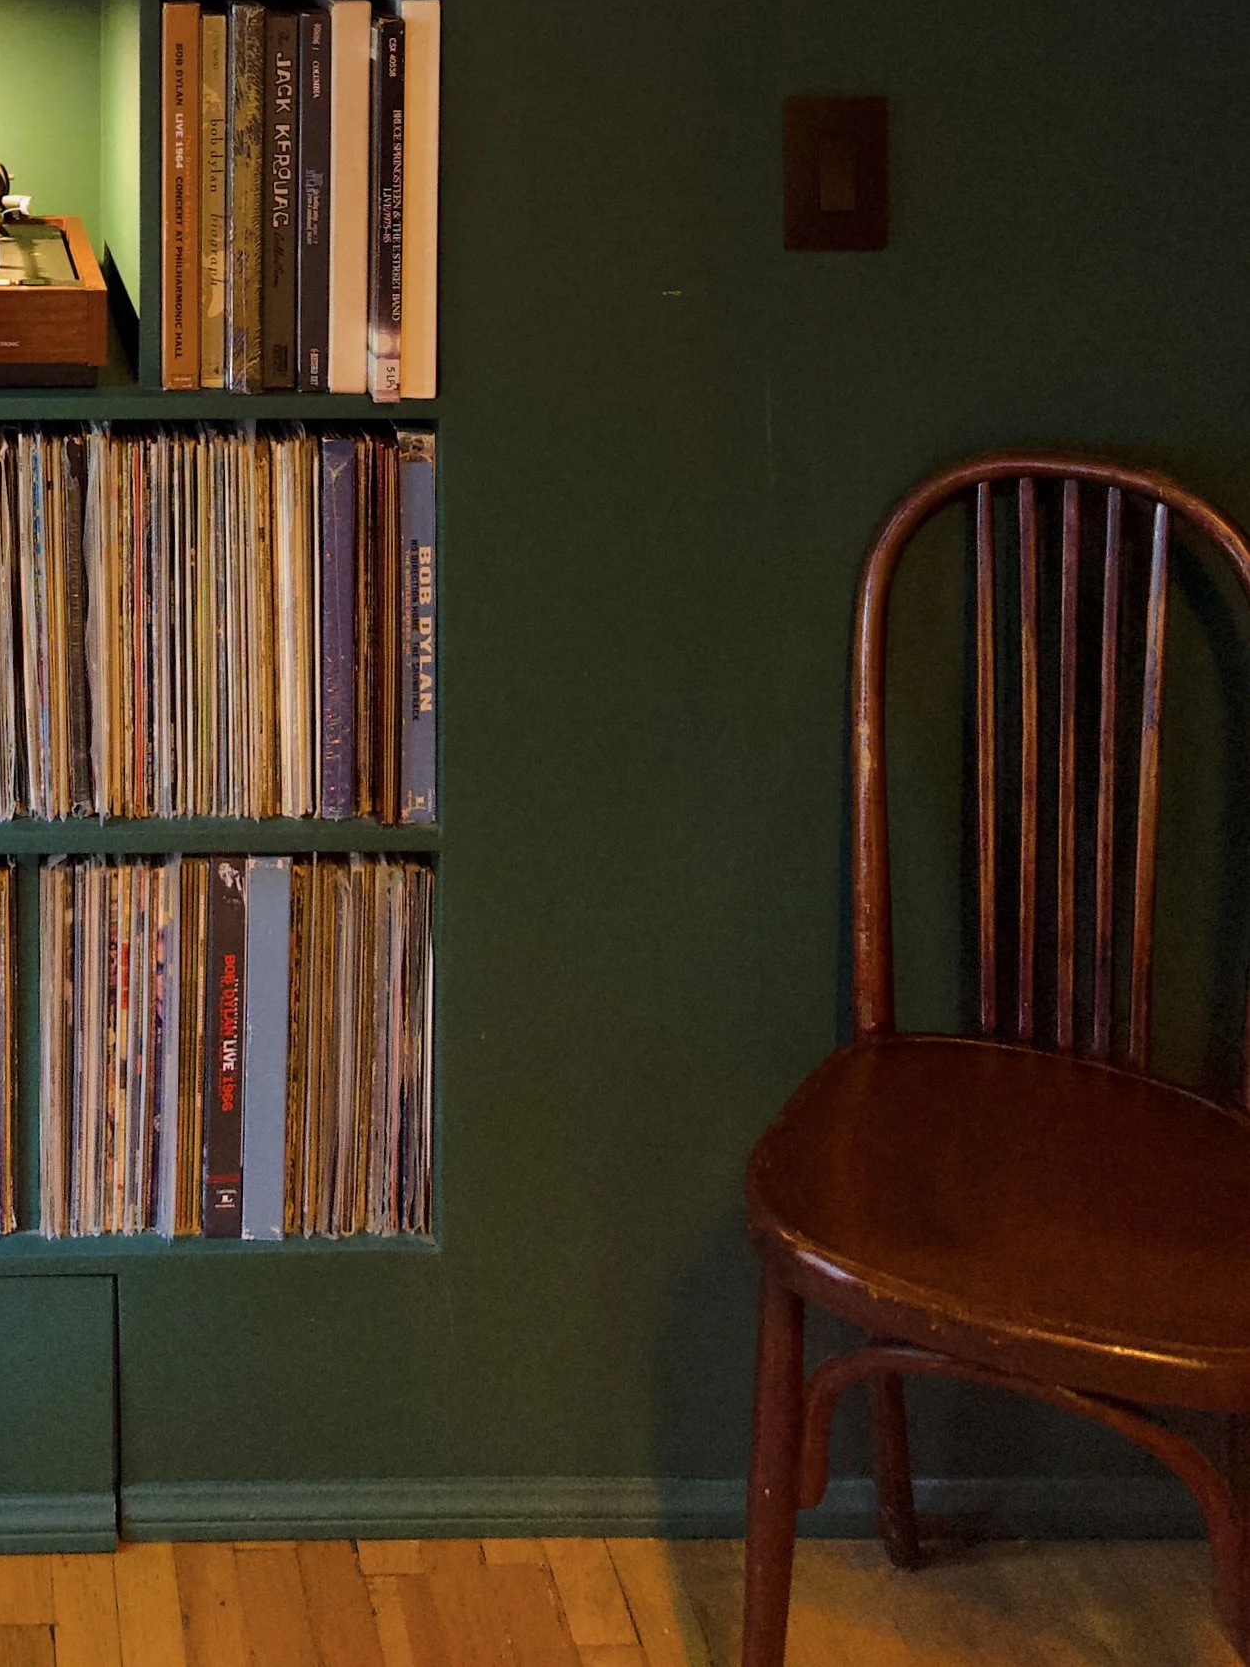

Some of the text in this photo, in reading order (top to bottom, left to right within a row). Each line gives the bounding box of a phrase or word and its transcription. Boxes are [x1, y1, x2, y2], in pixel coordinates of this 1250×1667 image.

[175, 42, 183, 66] BOB
[388, 53, 398, 78] 40558
[175, 69, 183, 106] DYLAN
[275, 52, 294, 114] JACK
[312, 60, 321, 99] COLUMBIA
[175, 113, 184, 137] LIVE
[392, 109, 402, 141] BRUCE
[175, 141, 184, 170] 1964
[207, 118, 224, 193] bob dylan
[272, 123, 294, 228] KEROUAC
[392, 142, 402, 209] SPRINGSTEEN
[175, 176, 183, 226] CONCERT
[392, 210, 401, 219] &
[175, 230, 183, 242] AT
[203, 214, 224, 286] biograph
[392, 221, 401, 243] THE
[174, 246, 183, 329] PHILHARMONIC
[392, 252, 402, 290] STREET
[391, 293, 401, 321] BAND
[174, 332, 183, 359] HALL
[411, 539, 419, 551] NO
[411, 554, 419, 603] DIRECTION
[418, 545, 432, 711] BOB DYLAN
[412, 661, 420, 722] SOUNDTRACK
[222, 953, 237, 1112] BOB DYLAN LIVE 1966
